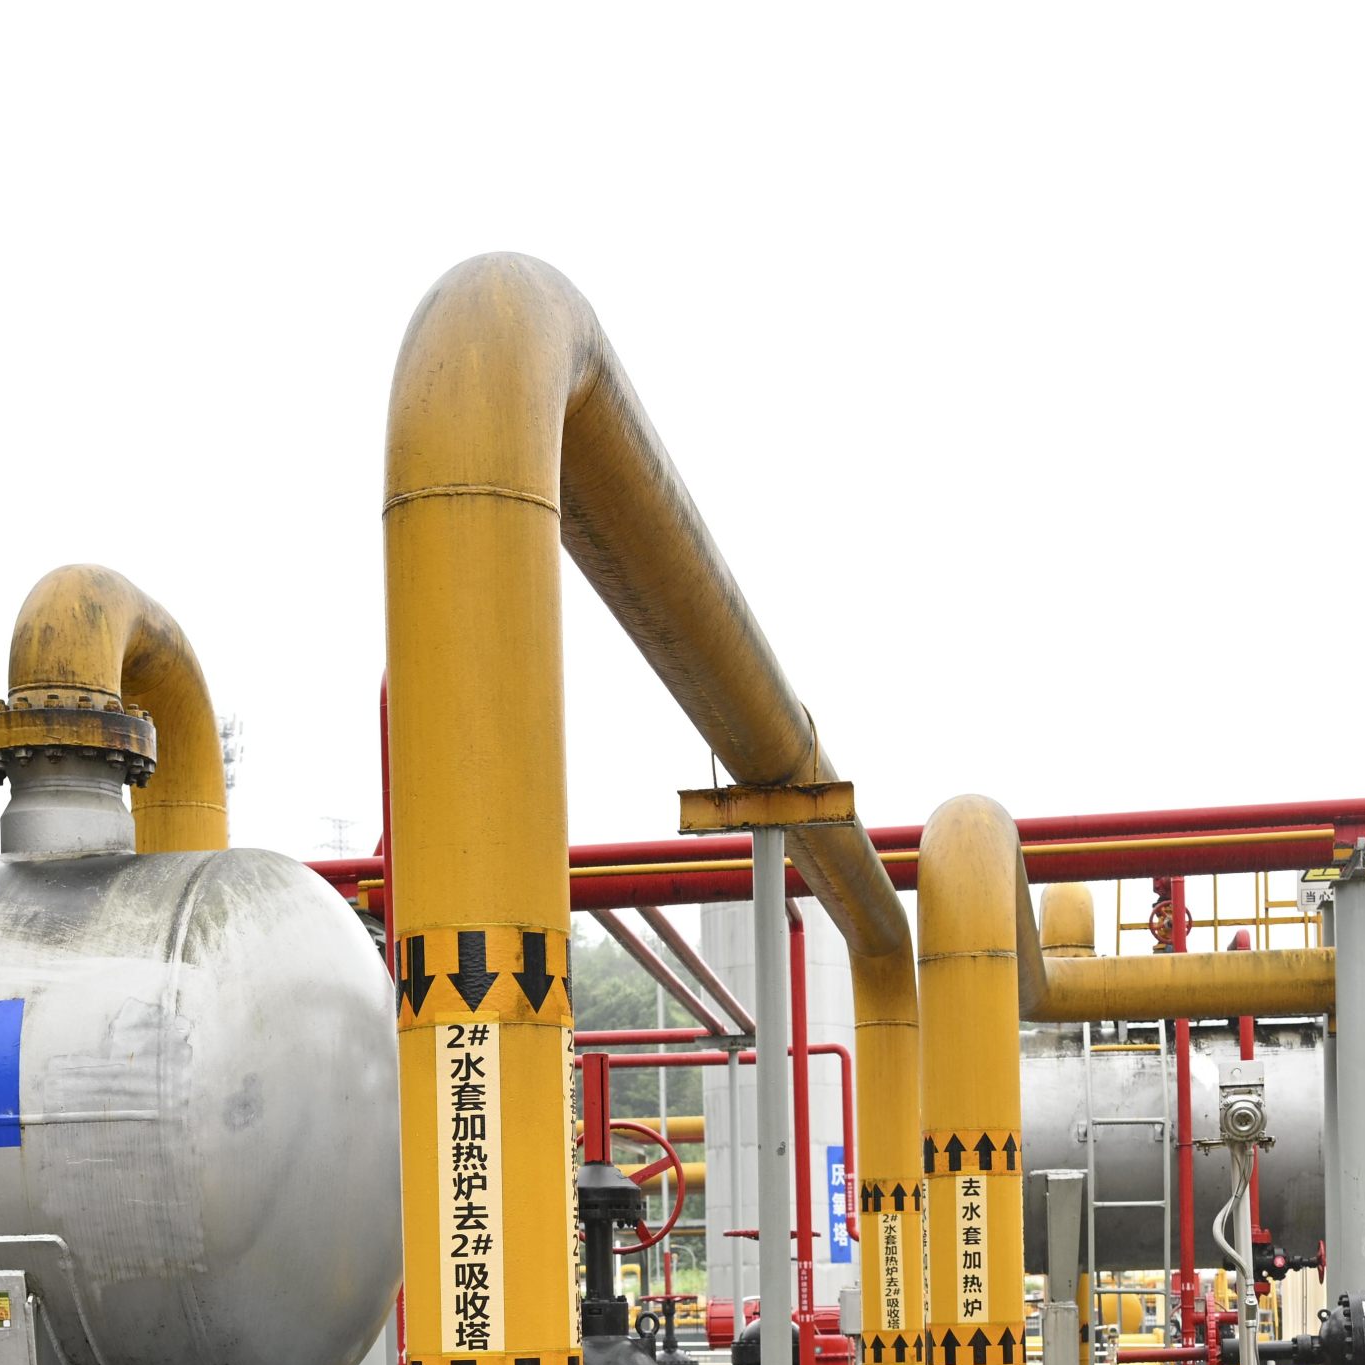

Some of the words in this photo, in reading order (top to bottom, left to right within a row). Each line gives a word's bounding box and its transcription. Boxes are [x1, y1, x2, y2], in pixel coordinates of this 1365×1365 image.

[446, 1024, 493, 1351] 2#水套加热炉去2#吸收塔
[961, 1178, 982, 1318] 去水套加热炉
[882, 1214, 900, 1330] 2#水套加热炉去2#吸收塔
